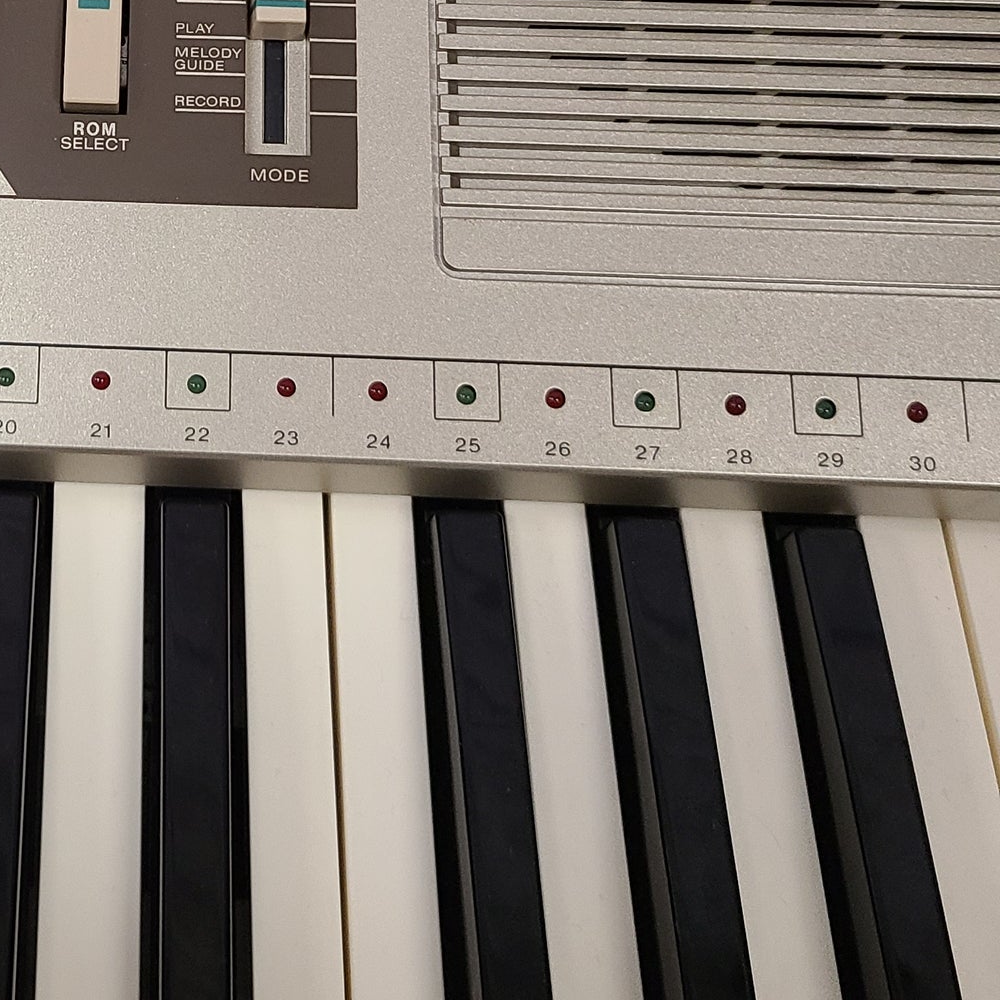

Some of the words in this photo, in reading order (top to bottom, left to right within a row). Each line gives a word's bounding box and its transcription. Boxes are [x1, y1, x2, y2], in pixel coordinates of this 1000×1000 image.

[175, 22, 215, 34] PLAY
[175, 46, 242, 59] MELODY
[174, 58, 225, 71] GUIDE
[174, 95, 241, 108] RECORD
[73, 121, 116, 137] ROM
[60, 136, 130, 151] SELECT
[250, 168, 309, 183] MODE
[90, 422, 111, 439] 21
[184, 426, 210, 443] 22
[366, 433, 391, 450] 24
[455, 437, 481, 453] 25
[545, 441, 571, 457] 26
[634, 444, 661, 461] 27
[726, 448, 753, 465] 28
[817, 452, 844, 468] 29
[909, 455, 937, 472] 30
